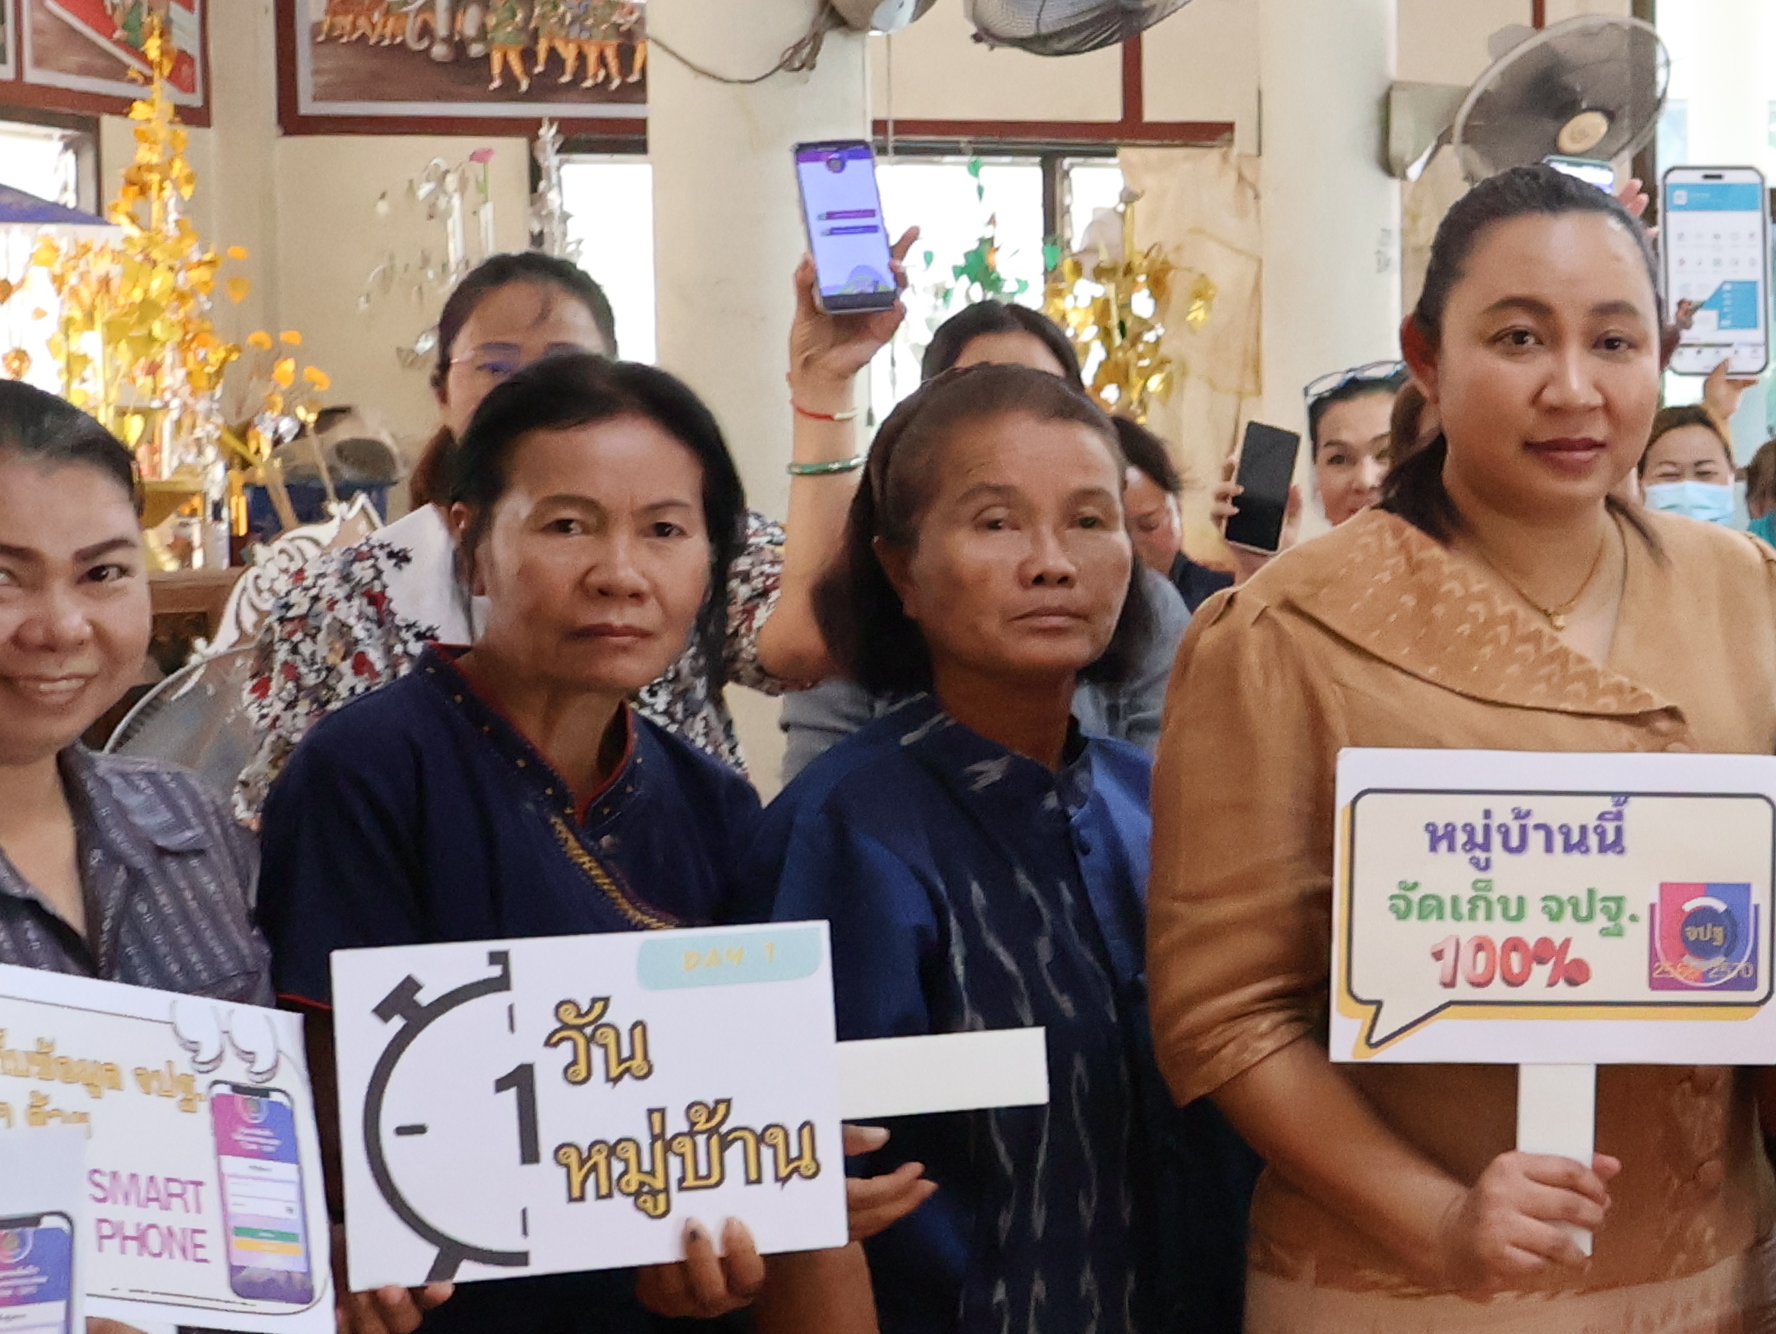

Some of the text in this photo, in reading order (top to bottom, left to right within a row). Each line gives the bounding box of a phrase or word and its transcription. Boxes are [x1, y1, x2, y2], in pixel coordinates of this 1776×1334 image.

[1425, 795, 1628, 872] หมู่บ้านนี้
[1388, 879, 1640, 937] จัดเก็บ จปฐ.
[681, 946, 744, 972] DAY
[1430, 934, 1592, 988] 100%
[0, 1028, 124, 1099] บข้อมูล
[545, 995, 653, 1085] วัน
[495, 1062, 541, 1165] 1
[555, 1098, 821, 1220] หมู่บ้าน
[89, 1168, 206, 1215] SMART
[95, 1216, 212, 1264] PHONE
